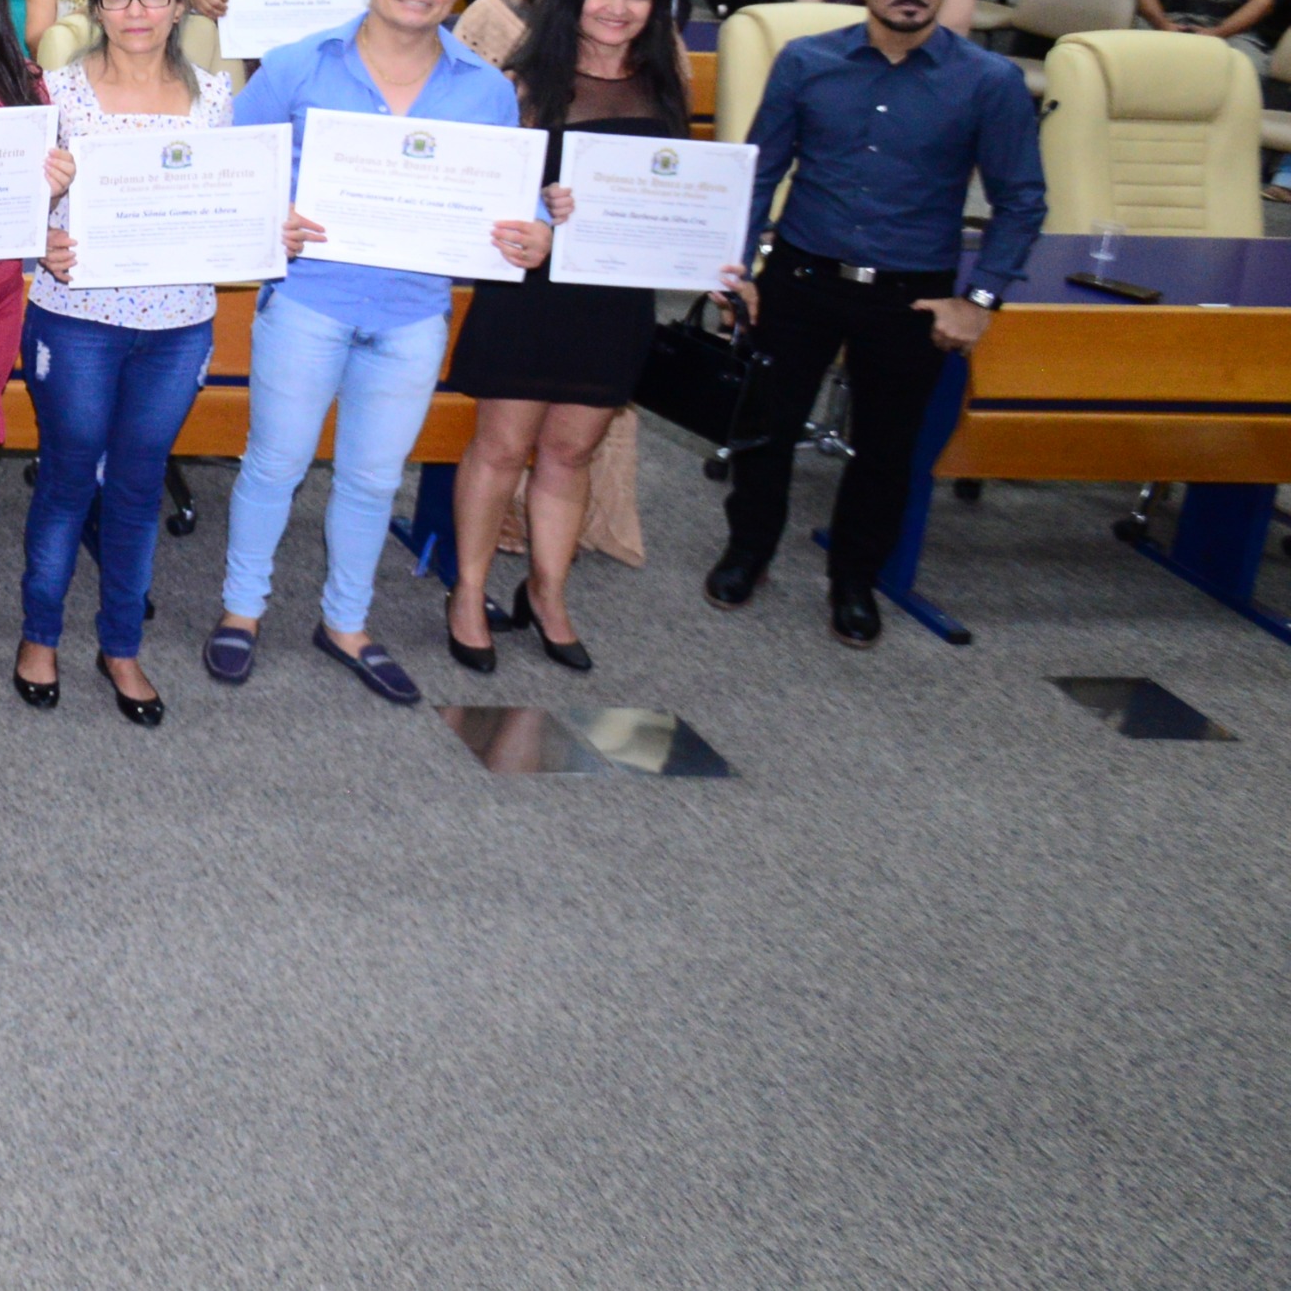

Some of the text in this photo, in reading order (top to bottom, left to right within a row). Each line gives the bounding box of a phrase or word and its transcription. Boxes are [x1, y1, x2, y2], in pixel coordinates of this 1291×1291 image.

[99, 169, 255, 187] Diploma de Honra ao Mérito
[116, 206, 237, 220] Maria Sônia Gomes de Abreu
